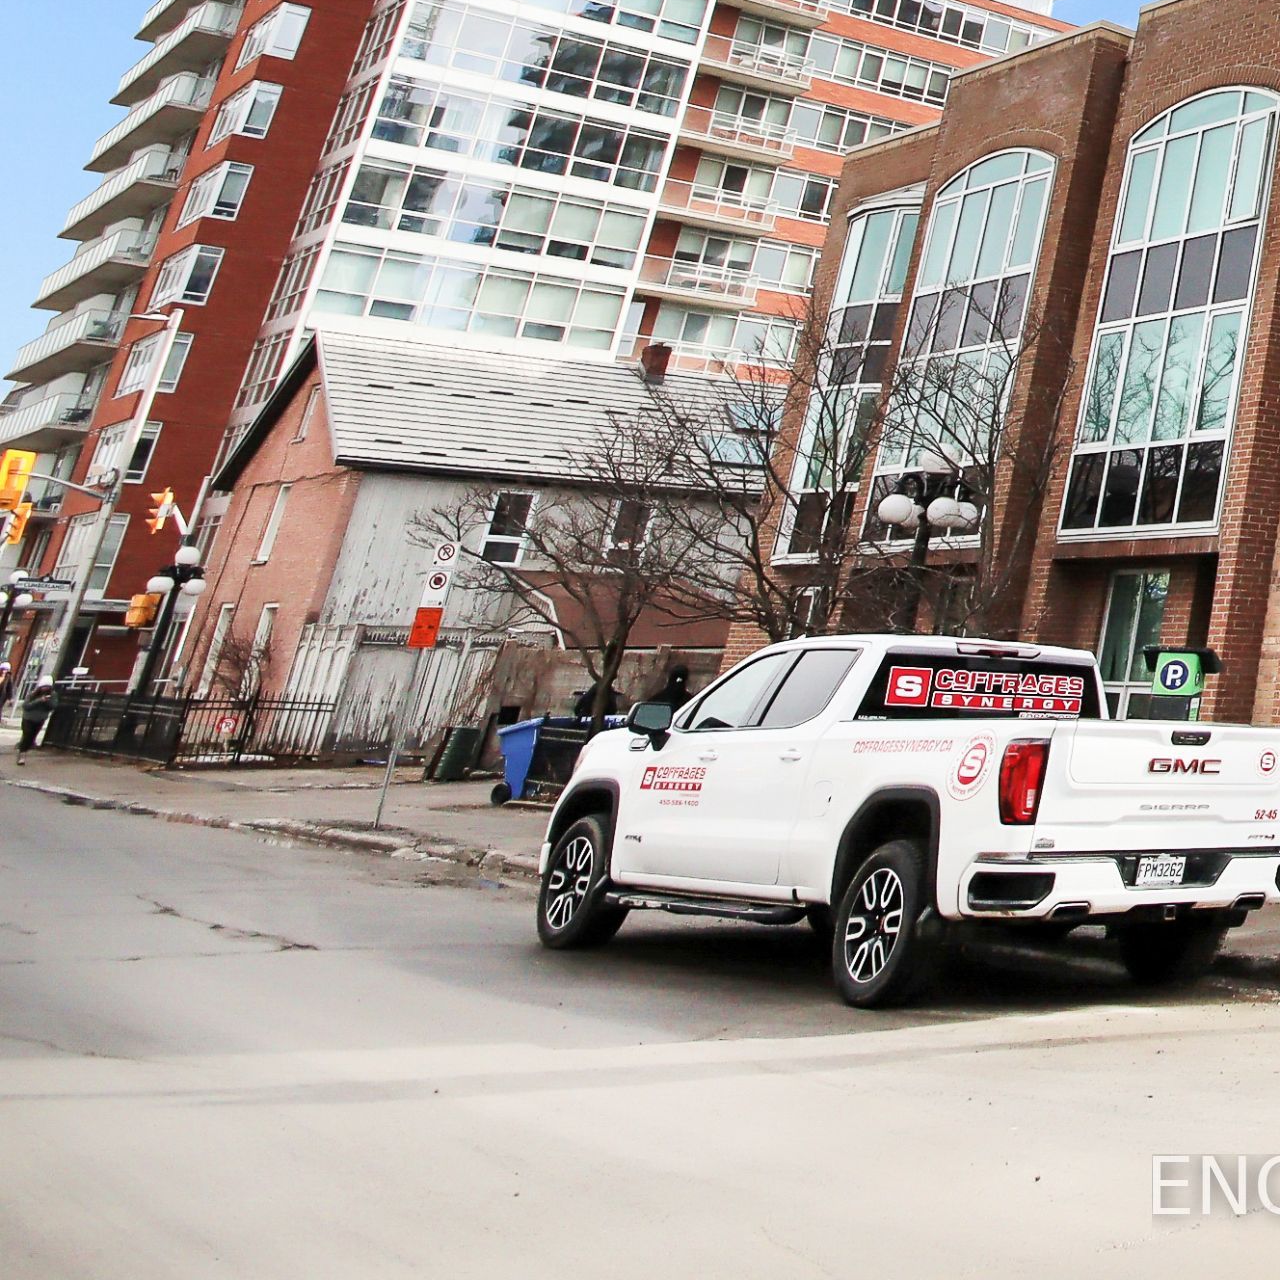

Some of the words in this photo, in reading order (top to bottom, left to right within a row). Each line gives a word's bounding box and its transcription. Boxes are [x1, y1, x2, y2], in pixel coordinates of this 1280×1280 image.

[935, 669, 1083, 696] COFFRAGES
[941, 695, 1074, 710] SYNERGY
[657, 767, 706, 779] COFFRAGES
[1148, 758, 1222, 774] GMC
[1254, 809, 1277, 819] 52-45
[1138, 862, 1183, 877] FPM3262
